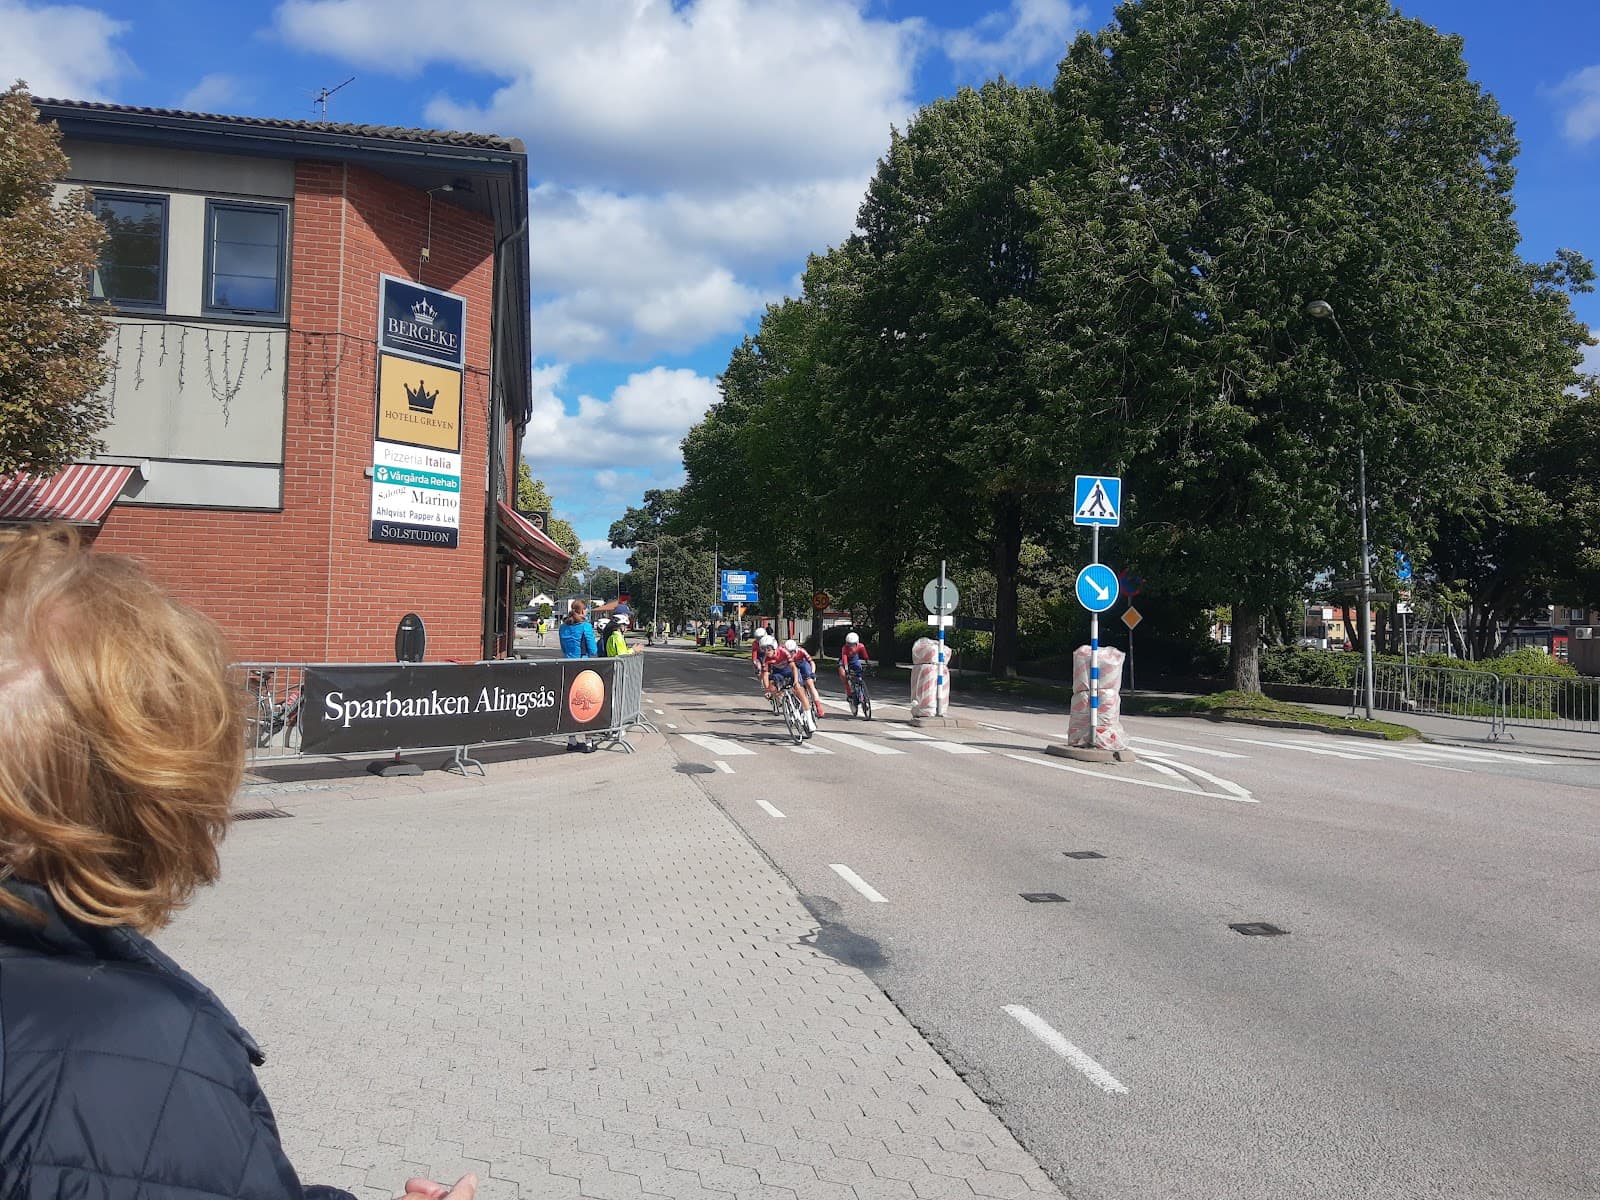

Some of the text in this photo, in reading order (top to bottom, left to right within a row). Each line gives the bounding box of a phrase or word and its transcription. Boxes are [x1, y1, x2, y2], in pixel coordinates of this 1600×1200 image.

[388, 317, 458, 348] BERGEKE
[385, 410, 454, 430] HOTELL GREVEN
[384, 448, 452, 469] Pizzeria Italia
[390, 470, 458, 488] Vårgårda Rehab
[411, 490, 458, 508] Marino
[376, 506, 406, 519] Ahlqvist
[409, 510, 434, 521] Papper
[443, 514, 456, 523] Lek
[381, 524, 450, 542] SOLSTUDION
[815, 596, 826, 605] 50
[324, 686, 555, 728] Sparbanken Alingsås
